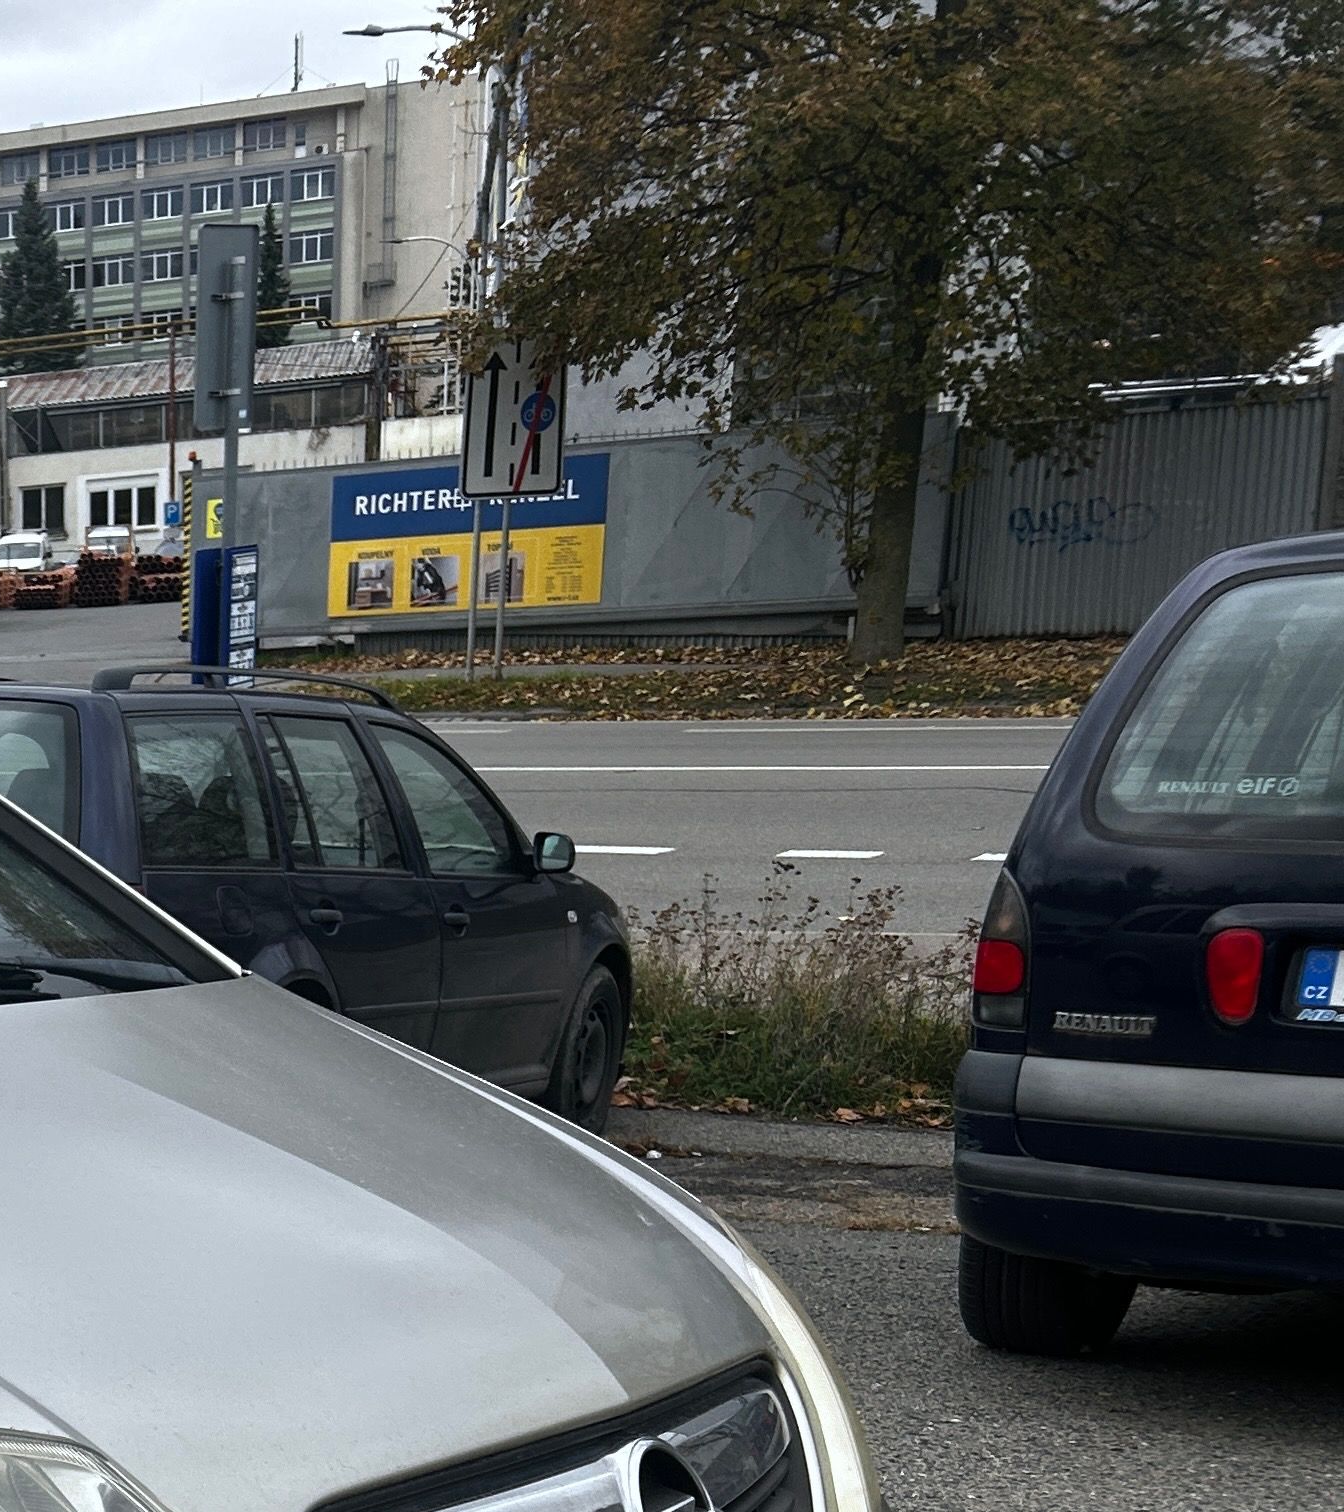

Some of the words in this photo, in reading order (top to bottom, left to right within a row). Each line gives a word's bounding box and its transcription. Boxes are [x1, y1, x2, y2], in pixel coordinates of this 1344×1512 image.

[355, 488, 452, 516] RICHTER
[1158, 780, 1230, 794] RENAULT
[1237, 777, 1276, 795] elf
[1304, 985, 1329, 999] CZ
[1053, 1011, 1157, 1036] RENAULT
